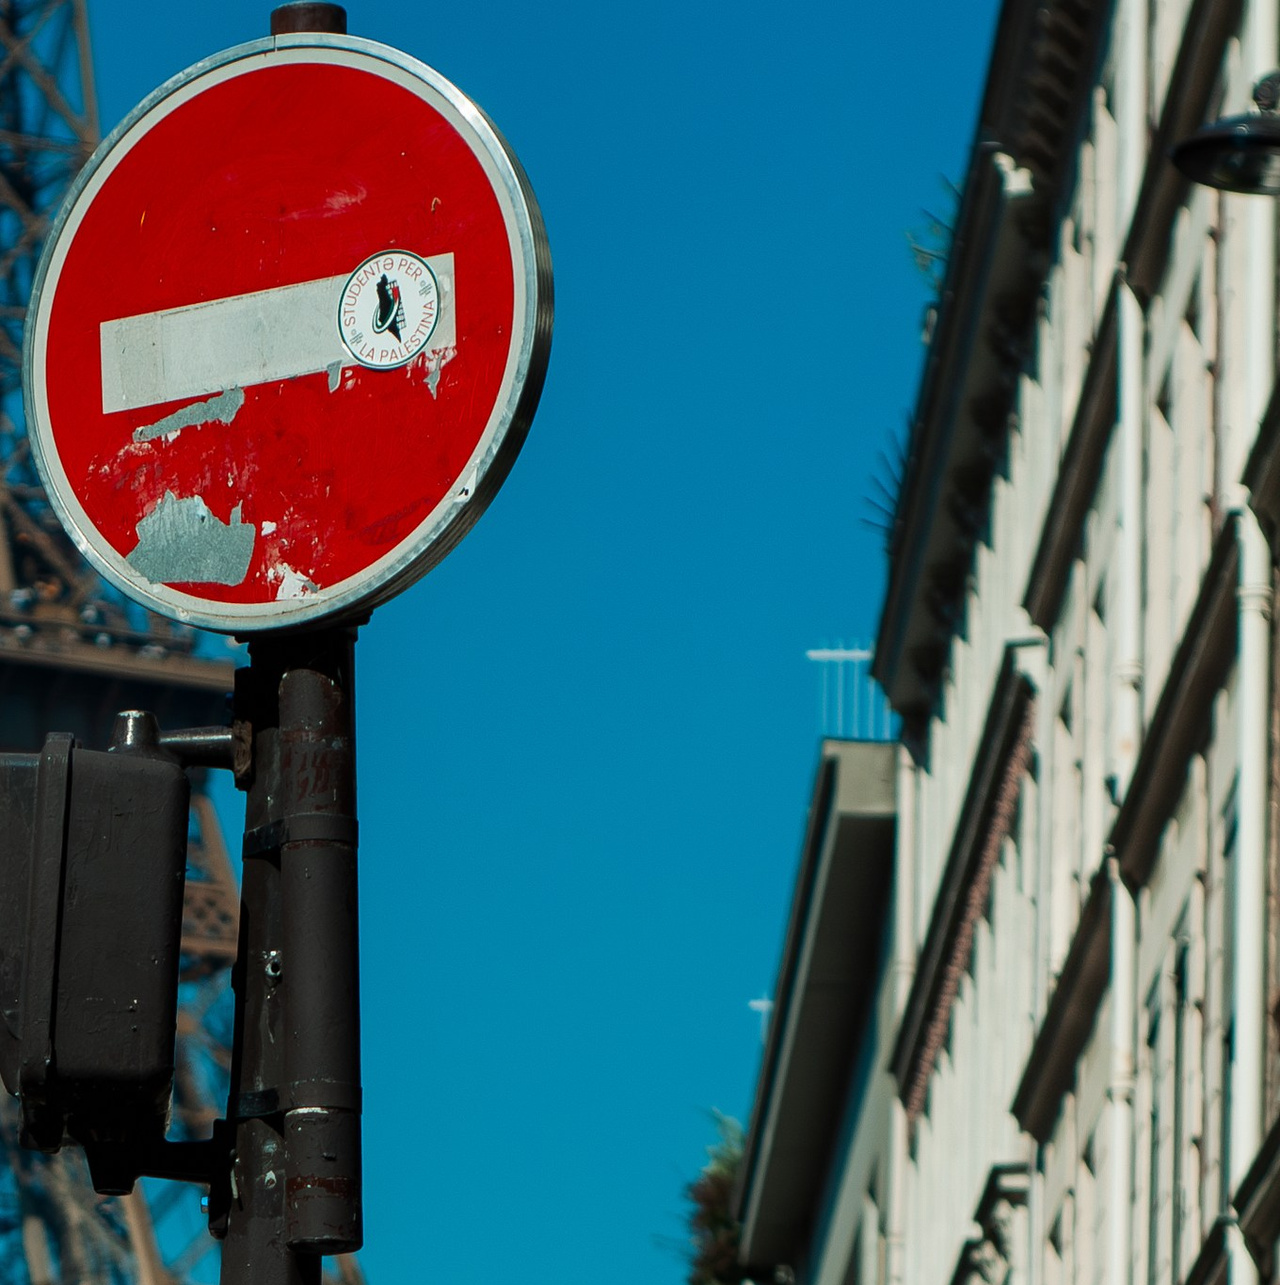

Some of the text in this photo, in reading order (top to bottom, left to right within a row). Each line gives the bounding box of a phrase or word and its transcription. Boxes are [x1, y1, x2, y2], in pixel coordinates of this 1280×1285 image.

[398, 258, 423, 282] PER
[359, 300, 434, 362] LA PALESTINA
